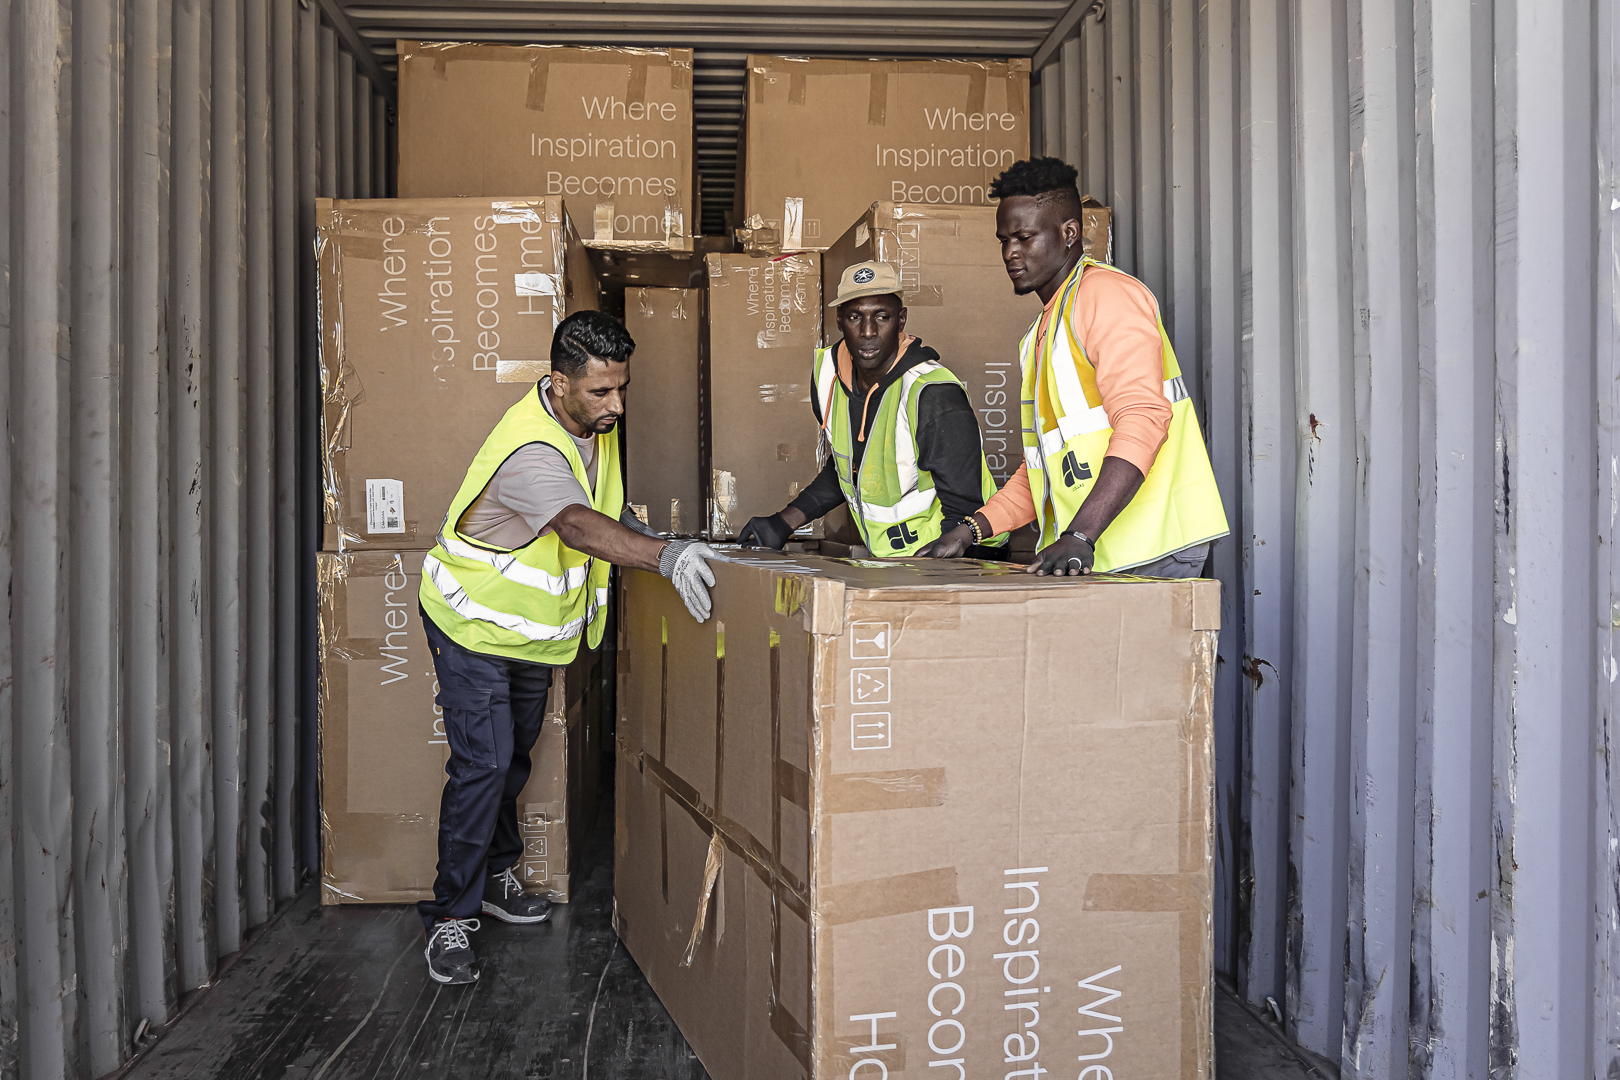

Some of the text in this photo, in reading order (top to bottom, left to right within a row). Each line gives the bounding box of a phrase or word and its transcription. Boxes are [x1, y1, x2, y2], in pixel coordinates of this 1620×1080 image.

[581, 95, 677, 122] Where
[924, 106, 1016, 131] Where
[530, 132, 677, 162] Inspiration
[876, 142, 1015, 172] Inspiration
[546, 171, 677, 197] Becomes
[377, 216, 409, 332] Where
[472, 215, 501, 371] Becomes
[746, 266, 760, 316] Where
[979, 362, 1014, 490] Inspirat
[378, 571, 409, 686] Where
[927, 905, 974, 1080] Beco
[993, 866, 1051, 1080] Inspirat
[849, 1011, 897, 1080] Ho
